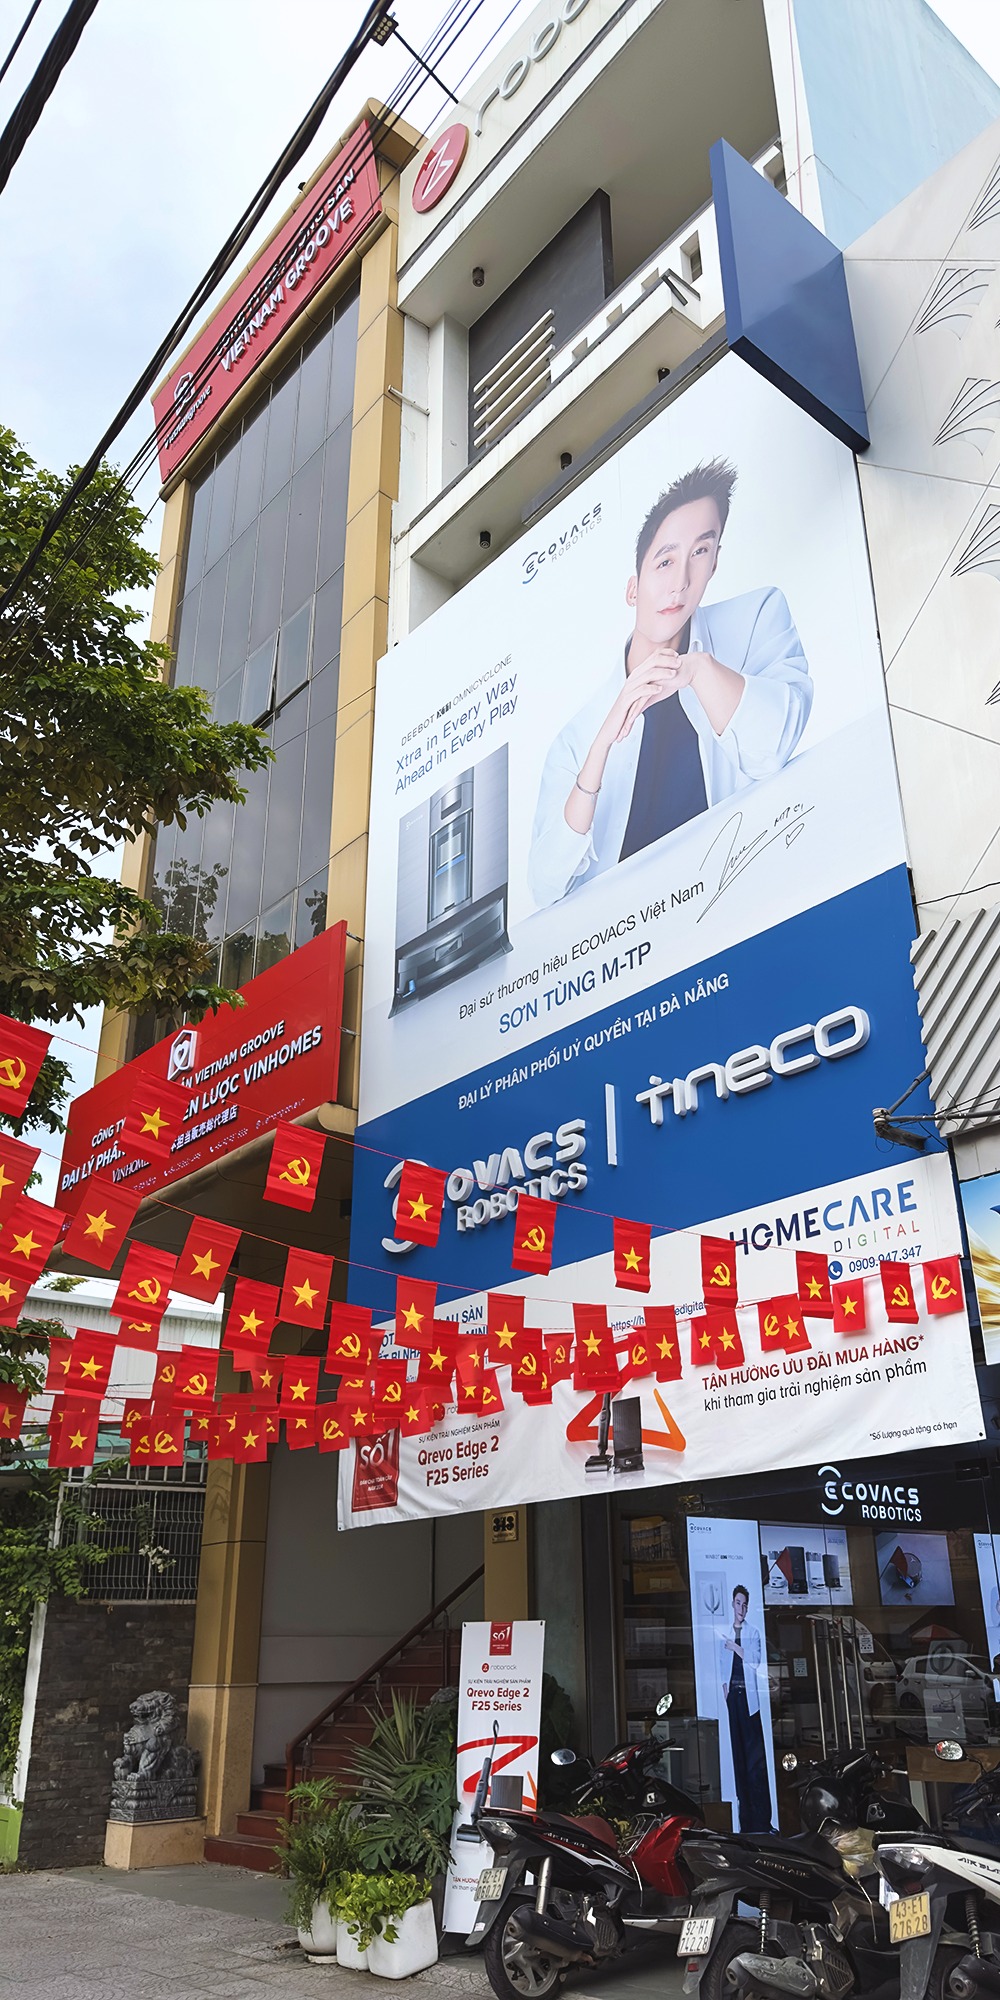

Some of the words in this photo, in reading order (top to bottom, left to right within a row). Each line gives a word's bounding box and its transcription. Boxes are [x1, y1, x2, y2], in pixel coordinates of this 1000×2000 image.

[221, 284, 285, 372] VIETNAM
[284, 196, 354, 291] GROOVE
[524, 503, 602, 577] ECOVACS
[551, 515, 602, 563] ROBOTICS
[395, 755, 433, 795] Ahead
[436, 748, 447, 765] in
[451, 719, 486, 754] Every
[489, 695, 519, 725] Play
[396, 747, 422, 775] Xtra
[426, 734, 438, 751] in
[443, 701, 481, 738] Every
[486, 673, 518, 705] Way
[401, 714, 436, 747] DEEBOT
[459, 999, 477, 1021] Đại
[479, 991, 494, 1006] sứ
[497, 968, 539, 1000] thương
[543, 951, 568, 976] hiệu
[571, 914, 636, 961] ECOVACS
[640, 898, 666, 924] Việt
[671, 881, 704, 909] Nam
[499, 998, 538, 1034] SƠN
[543, 969, 596, 1012] TÙNG
[602, 941, 652, 984] M-TP
[458, 1091, 477, 1111] ĐẠI
[480, 1078, 494, 1101] LÝ
[495, 1061, 529, 1094] PHÂN
[530, 1046, 561, 1078] PHỐI
[584, 1017, 632, 1053] QUYỀN
[634, 1007, 657, 1028] TẠI
[659, 993, 681, 1018] ĐÀ
[683, 972, 730, 1007] NẴNG
[61, 1166, 81, 1191] ĐẠI
[81, 1155, 96, 1179] LÝ
[201, 1073, 241, 1109] LƯỢC
[243, 1025, 323, 1086] VINHOMES
[91, 1124, 115, 1148] CÔNG
[195, 1049, 238, 1085] VIETNAM
[239, 1020, 286, 1058] GROOVE
[730, 1179, 918, 1255] HOMECARE
[834, 1220, 920, 1253] DIGITAL
[702, 1372, 728, 1392] TẬN
[731, 1364, 780, 1386] HƯỞNG
[783, 1358, 804, 1376] ƯU
[807, 1350, 832, 1371] ĐÃI
[835, 1346, 869, 1366] MUA
[704, 1396, 721, 1412] khi
[724, 1392, 754, 1409] tham
[757, 1388, 777, 1406] gia
[780, 1381, 801, 1398] trải
[804, 1374, 852, 1396] nghiệm
[855, 1367, 881, 1385] sản
[885, 1357, 927, 1382] phẩm
[418, 1448, 453, 1466] Qrevo
[456, 1441, 487, 1460] Edge
[490, 1435, 500, 1452] 2
[426, 1468, 449, 1487] F25
[452, 1462, 489, 1483] Series
[823, 1479, 919, 1506] ECOVACS
[861, 1504, 922, 1522] ROBOTICS
[467, 1687, 495, 1698] Qrevo
[497, 1687, 521, 1700] Edge
[523, 1687, 530, 1698] 2
[471, 1701, 491, 1711] F25
[493, 1700, 522, 1711] Series
[892, 1914, 928, 1941] 276.28
